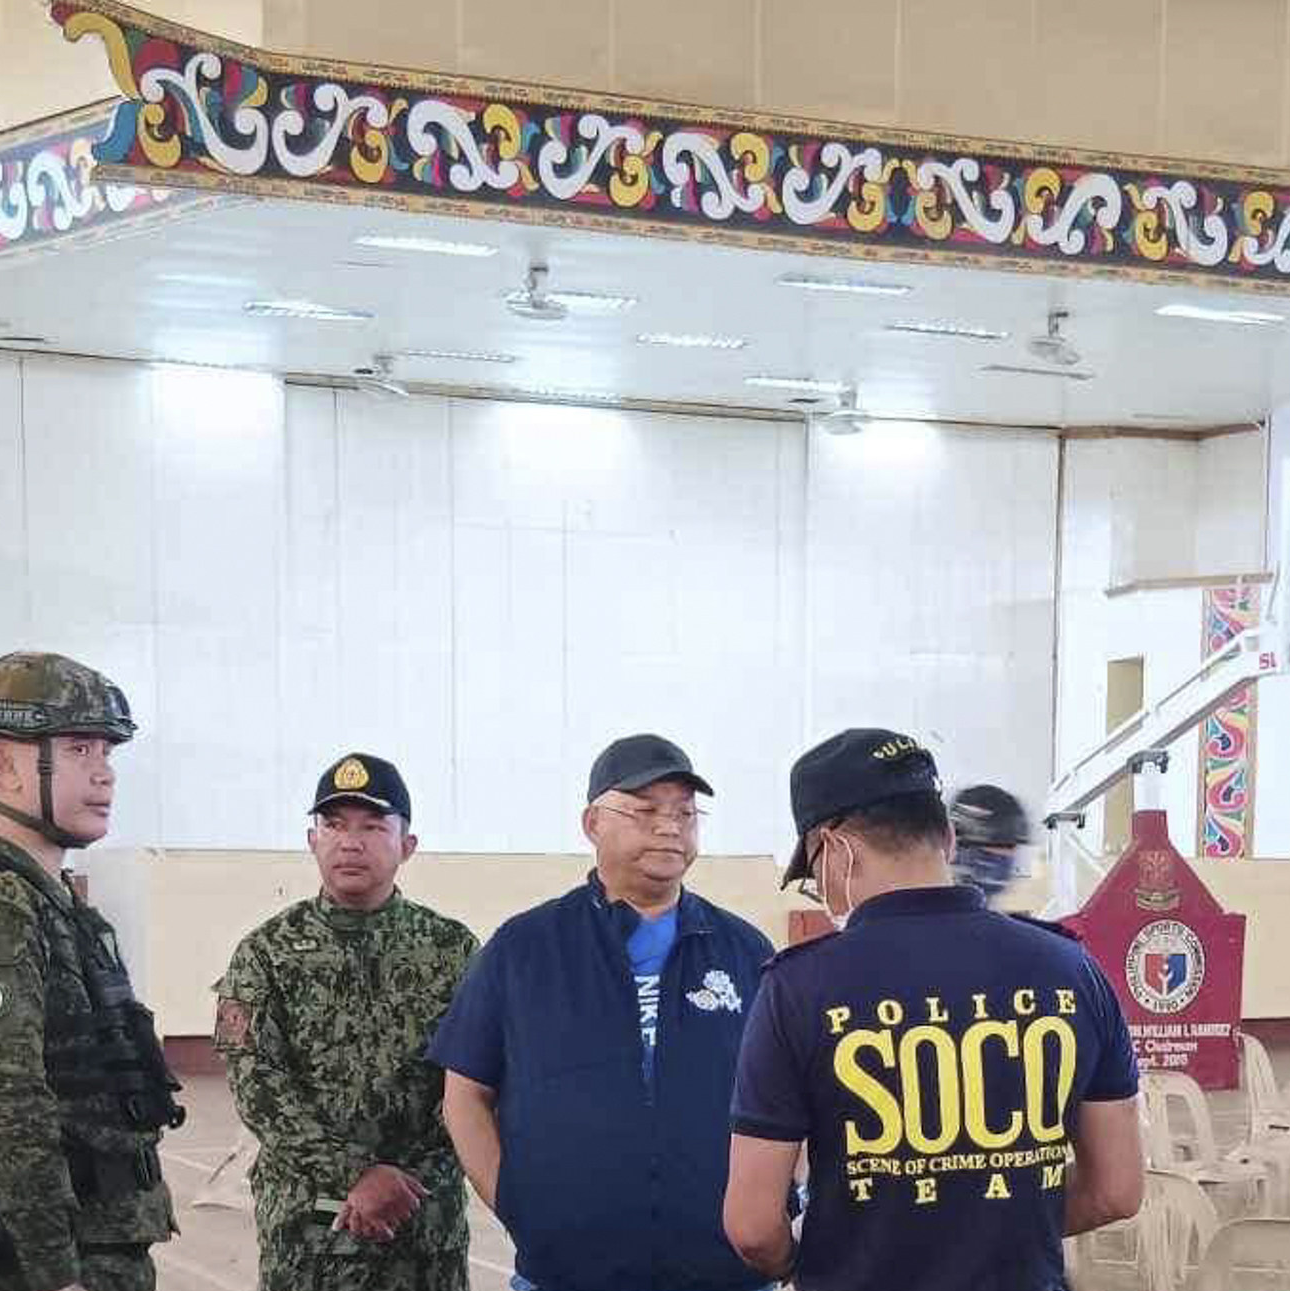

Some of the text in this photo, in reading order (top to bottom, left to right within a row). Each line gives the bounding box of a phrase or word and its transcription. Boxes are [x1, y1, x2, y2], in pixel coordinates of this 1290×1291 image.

[634, 974, 660, 1047] NIKE
[826, 989, 1077, 1034] POLICE
[833, 1016, 1077, 1155] SOCO
[847, 1157, 902, 1176] SCENE
[905, 1158, 927, 1175] OF
[929, 1153, 987, 1172] CRIME
[850, 1164, 1064, 1204] TEAM
